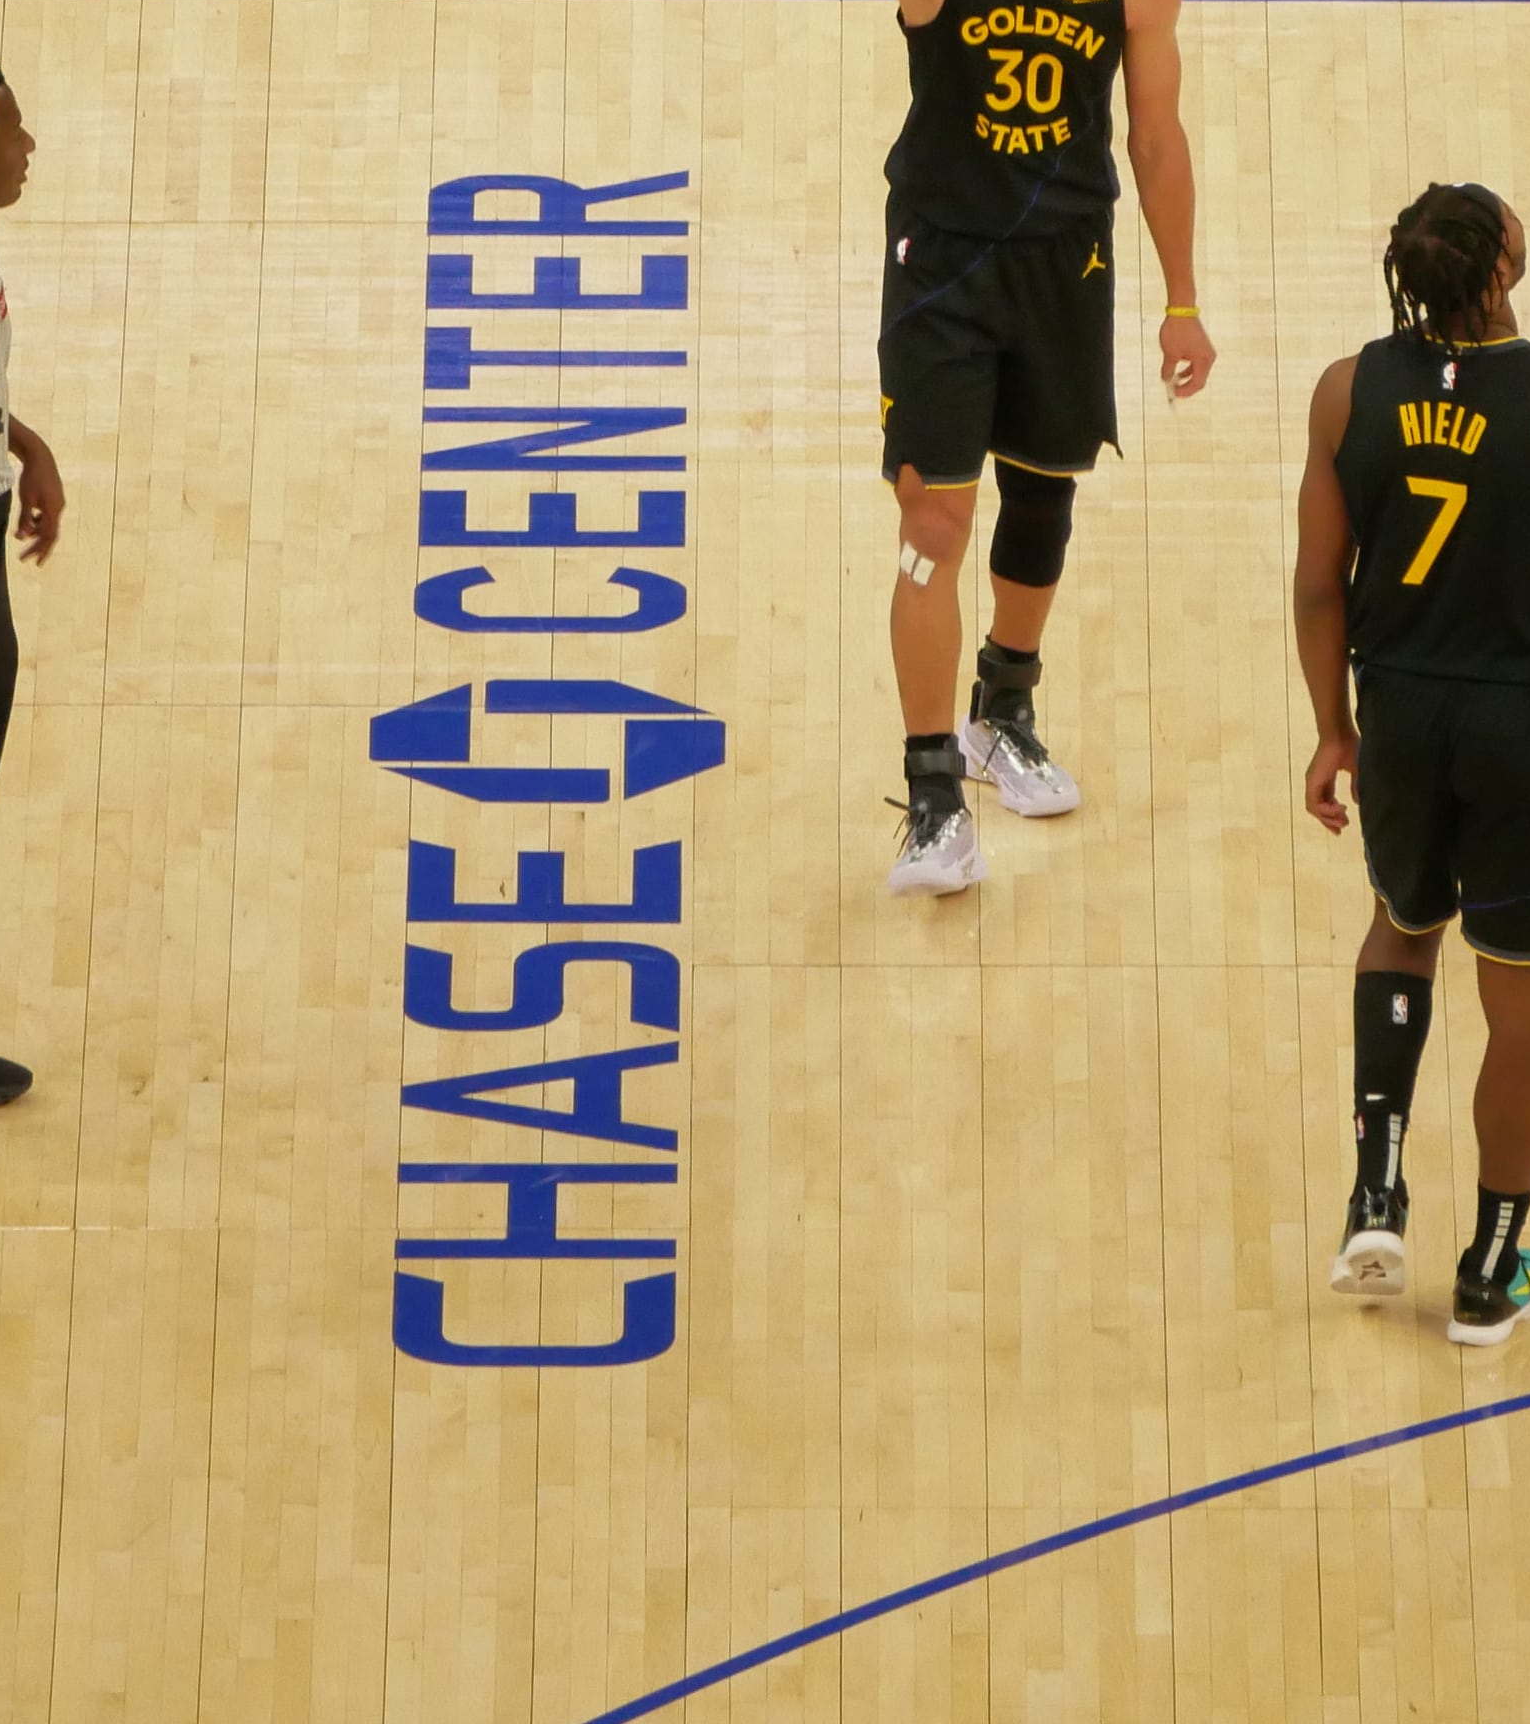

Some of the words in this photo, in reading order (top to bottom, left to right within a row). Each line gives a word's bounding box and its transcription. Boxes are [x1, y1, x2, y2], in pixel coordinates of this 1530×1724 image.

[961, 5, 1105, 60] GOLDEN
[985, 48, 1063, 114] 30
[975, 113, 1071, 154] STATE
[413, 171, 688, 633] CENTER
[1399, 401, 1487, 455] HIELD
[1401, 476, 1468, 585] 7
[393, 840, 682, 1367] CHASE
